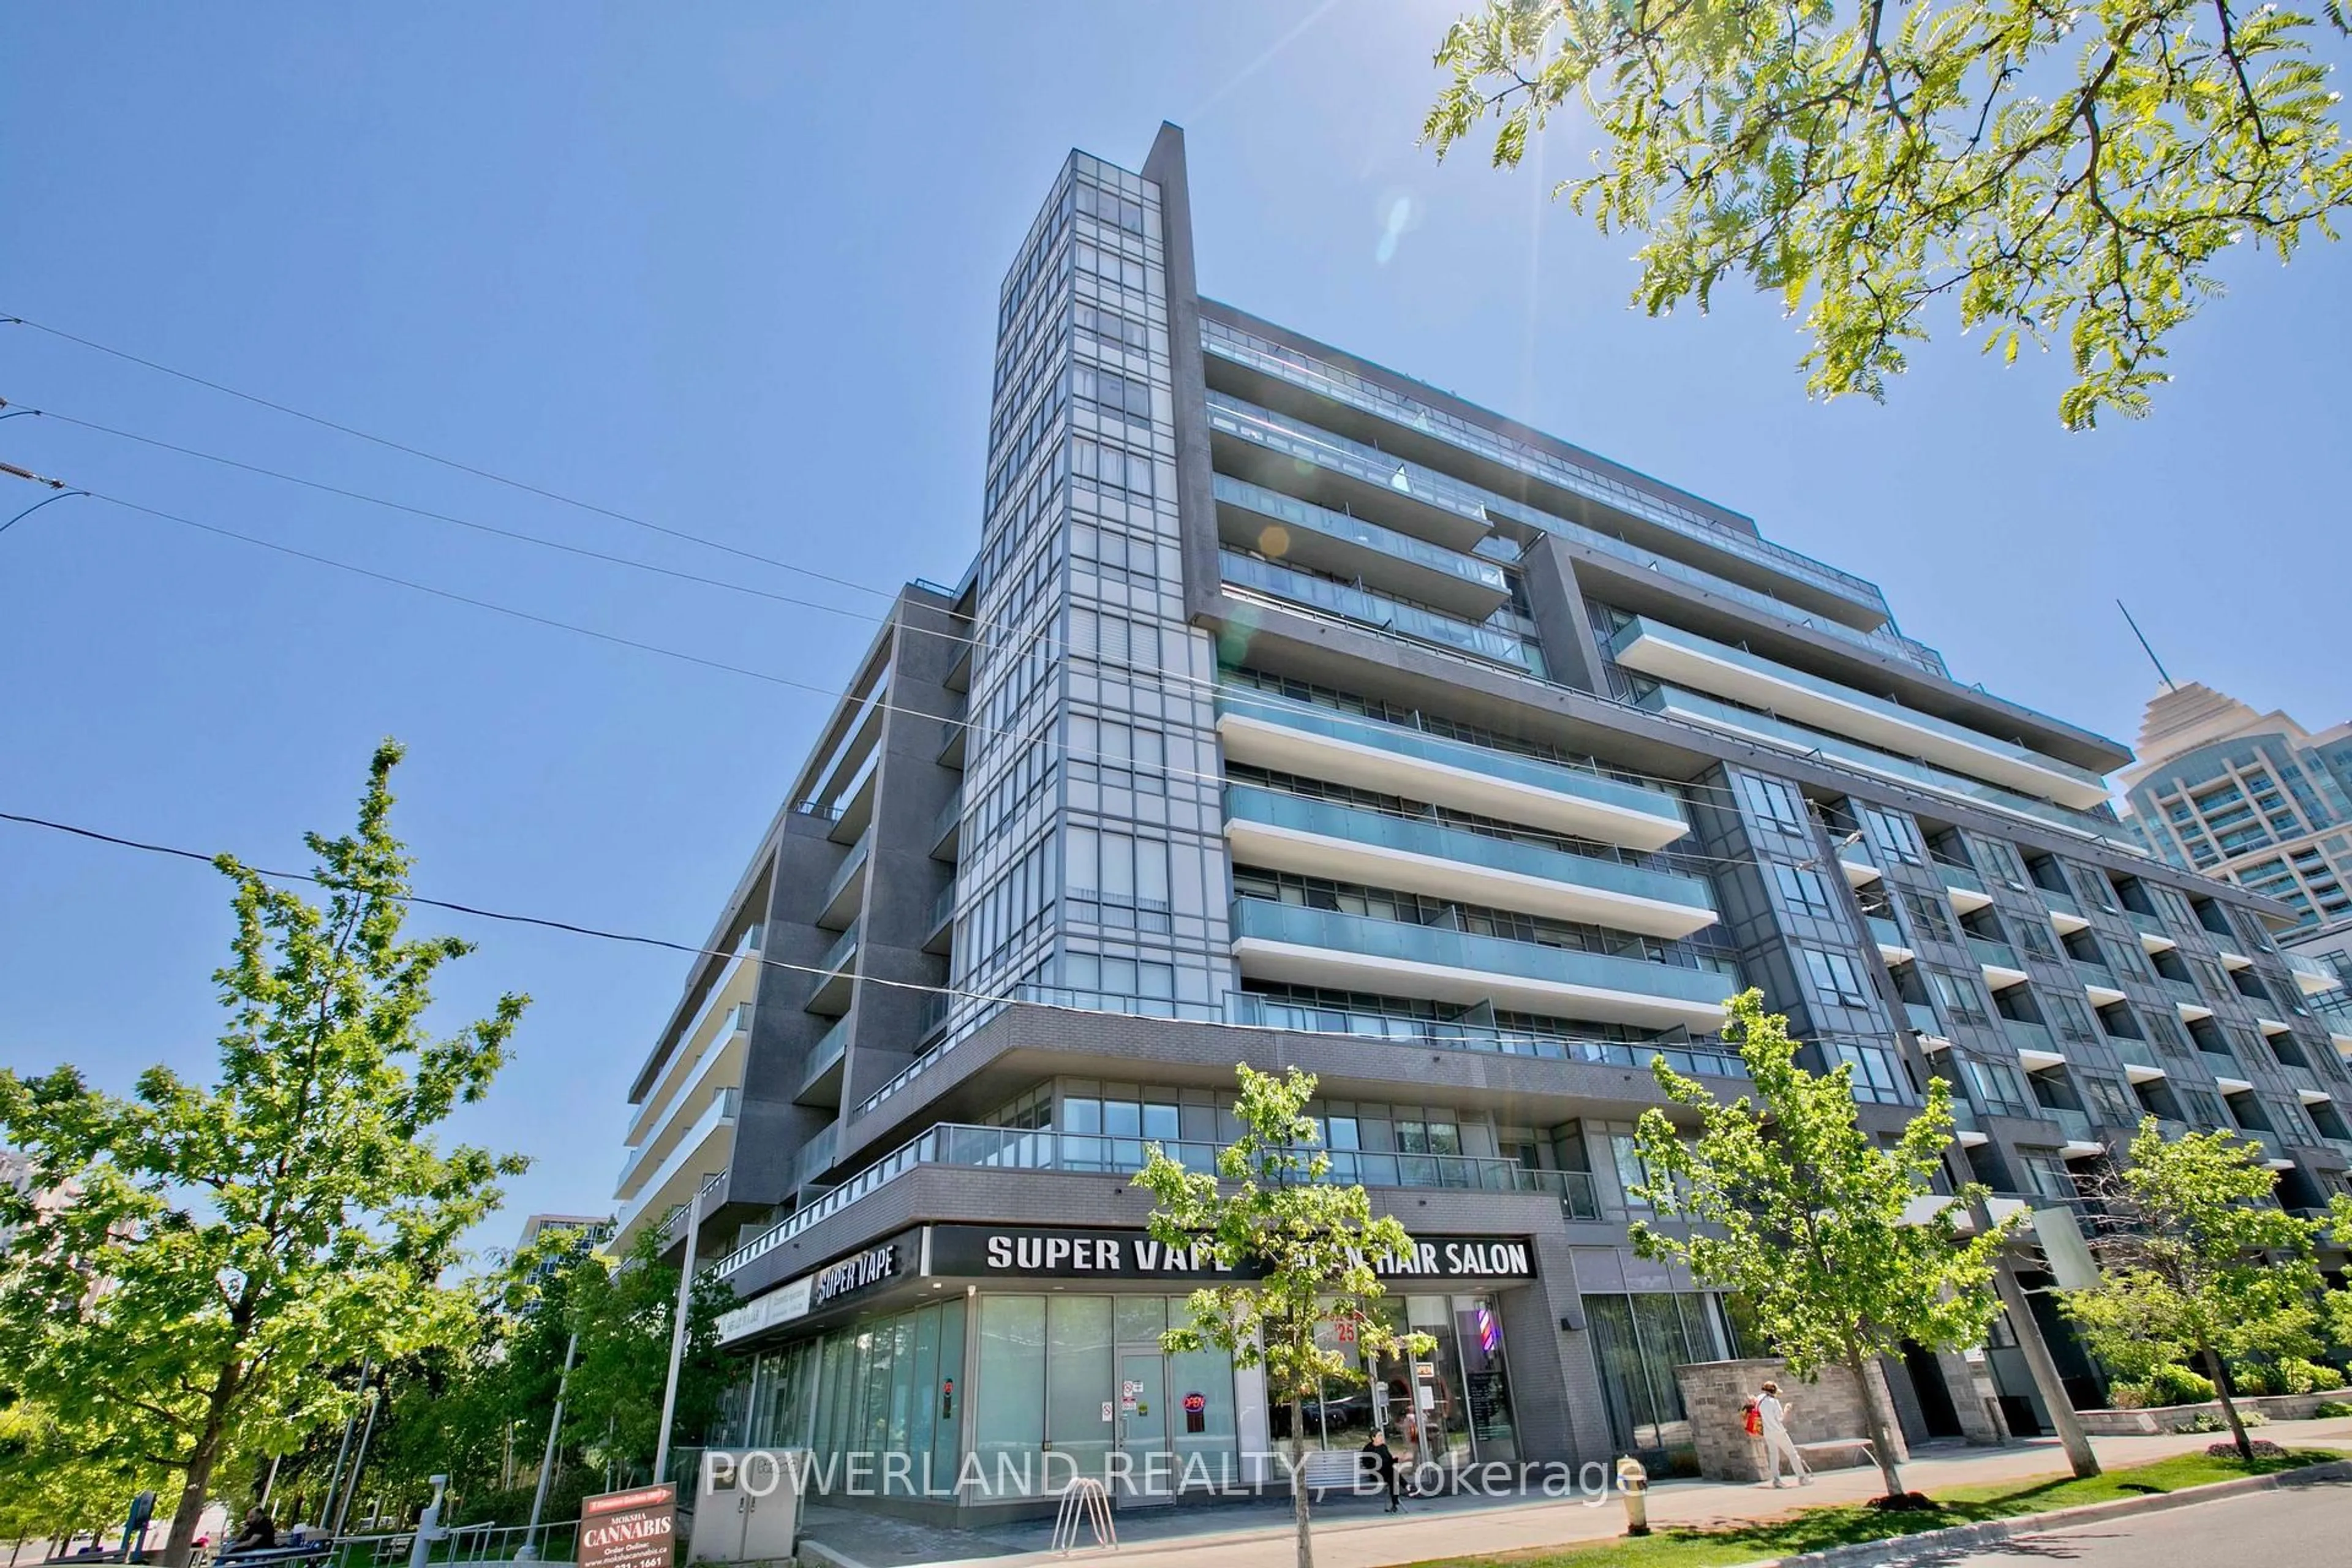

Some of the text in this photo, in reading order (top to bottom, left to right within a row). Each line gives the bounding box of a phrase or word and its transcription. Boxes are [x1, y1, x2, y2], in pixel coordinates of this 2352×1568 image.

[987, 1235, 1120, 1270] SUPER
[1376, 1243, 1440, 1275] HAIR
[1446, 1243, 1528, 1275] SALON
[818, 1262, 856, 1300] SUPER
[859, 1245, 894, 1286] VAPE
[584, 1516, 671, 1548] CANNABIS
[604, 1546, 625, 1555] Order
[640, 1557, 662, 1568] 1661
